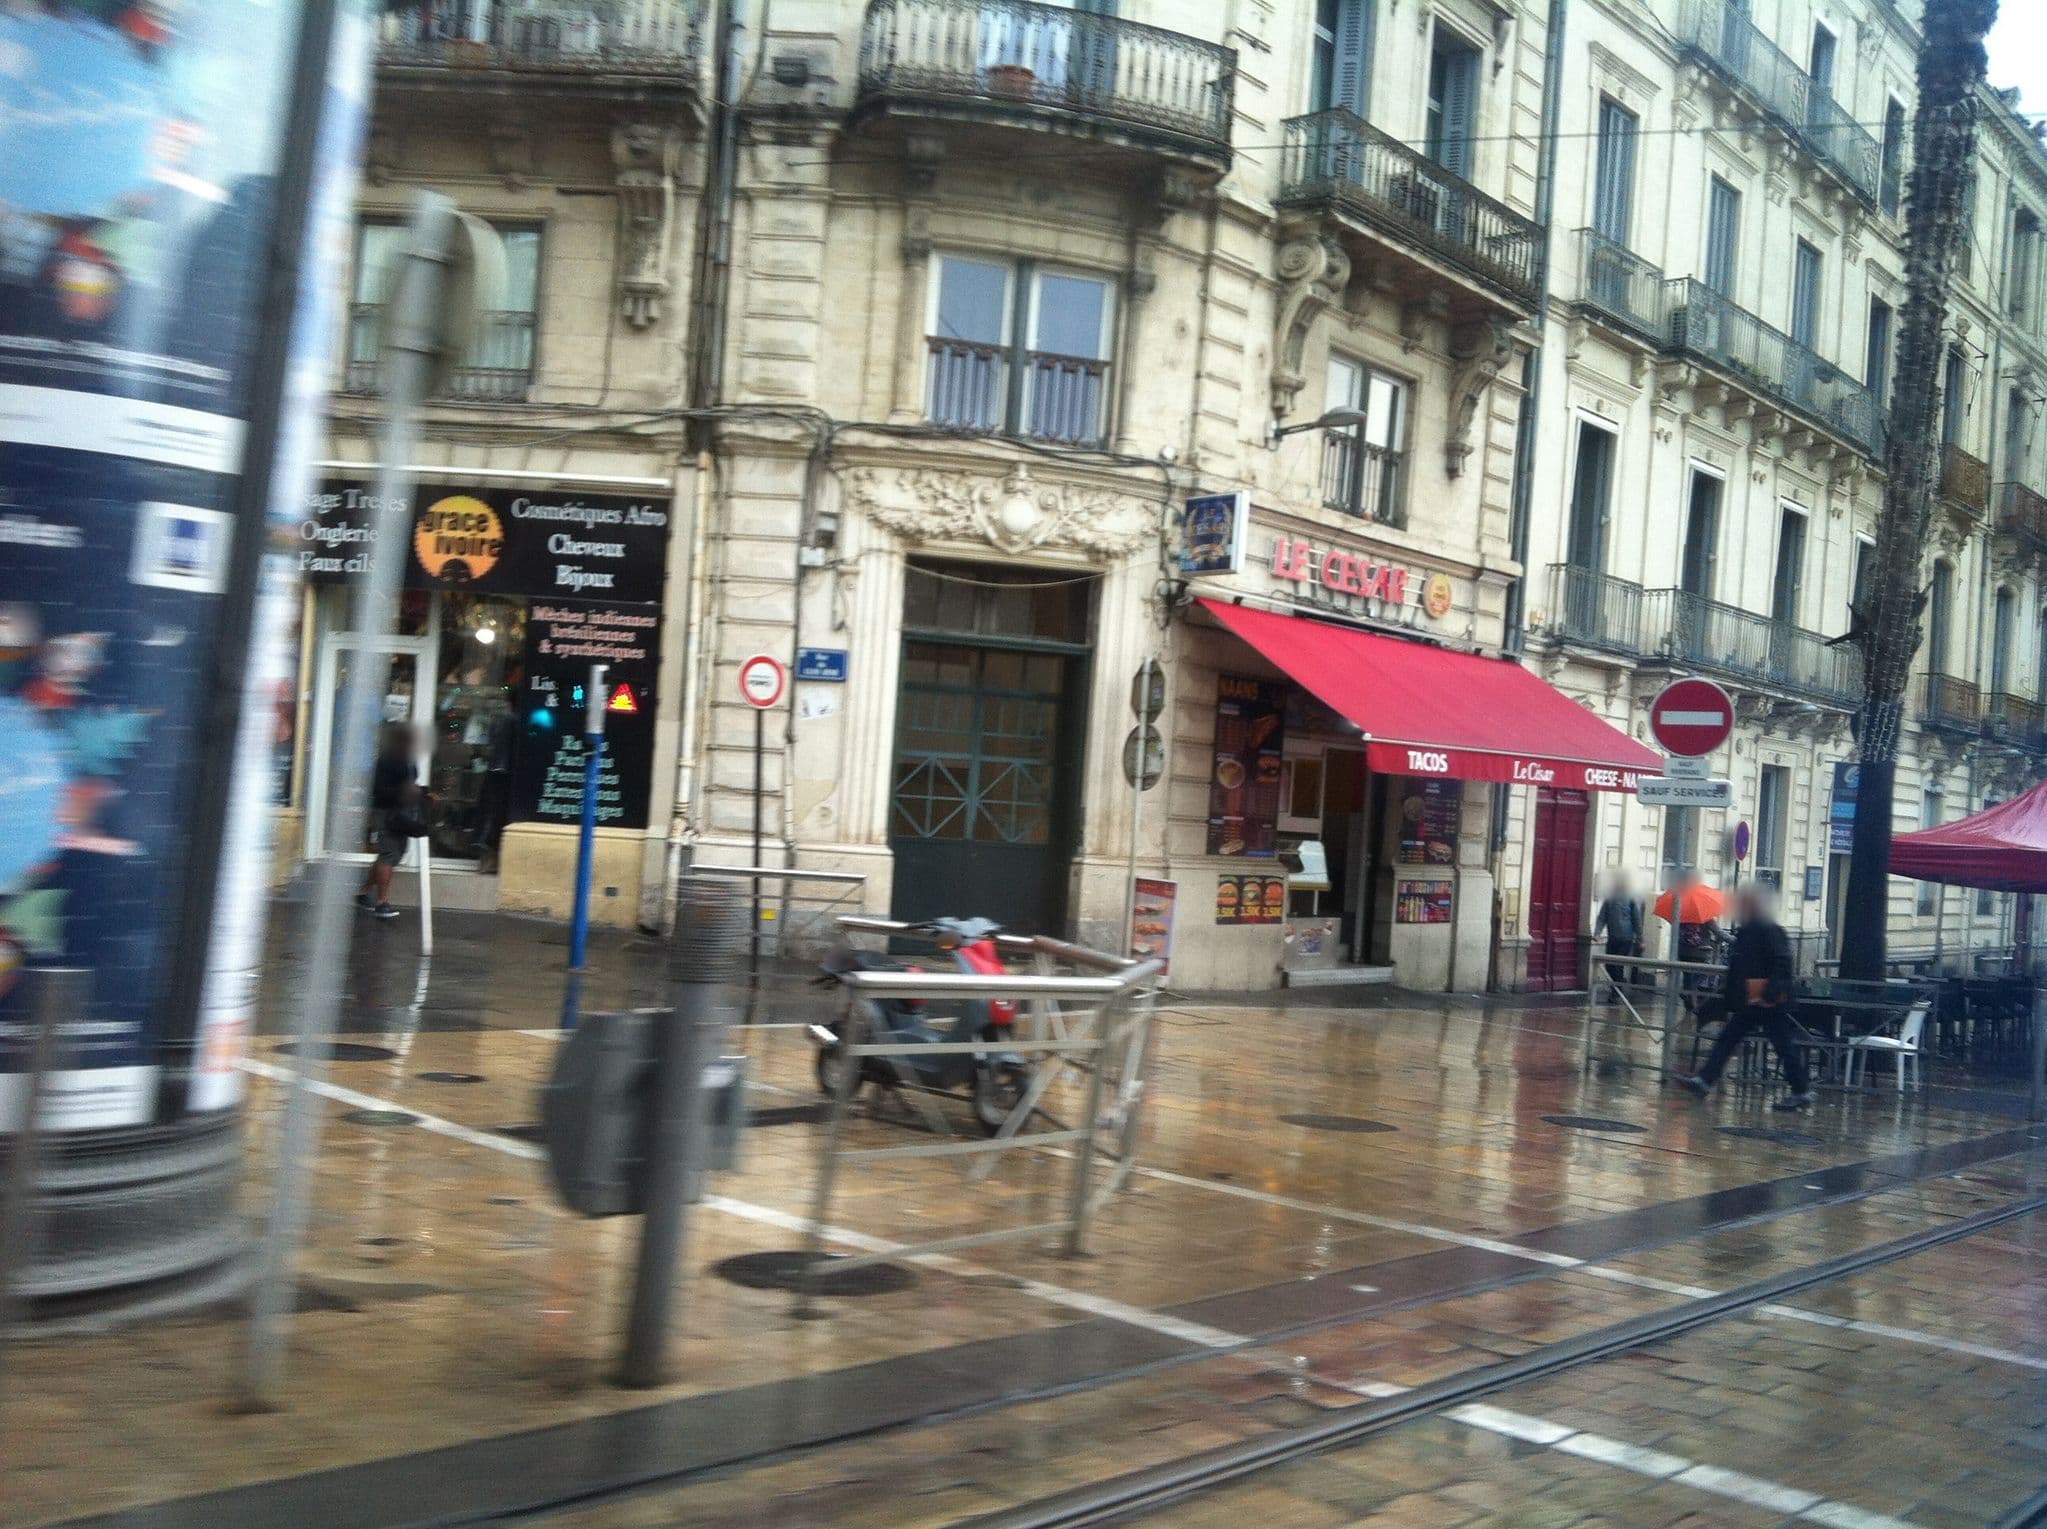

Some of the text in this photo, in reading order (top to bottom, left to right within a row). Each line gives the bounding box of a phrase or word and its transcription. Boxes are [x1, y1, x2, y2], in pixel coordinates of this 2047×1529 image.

[511, 498, 623, 528] Cosmétiques
[301, 520, 380, 548] Onglerie
[548, 533, 626, 557] Cheveux
[1271, 537, 1309, 581] LE
[555, 565, 615, 592] Bijoux
[588, 609, 657, 627] indiennes
[1407, 750, 1448, 773] TACOS
[1513, 760, 1527, 779] Le
[1642, 787, 1726, 798] SAUF SERVICES
